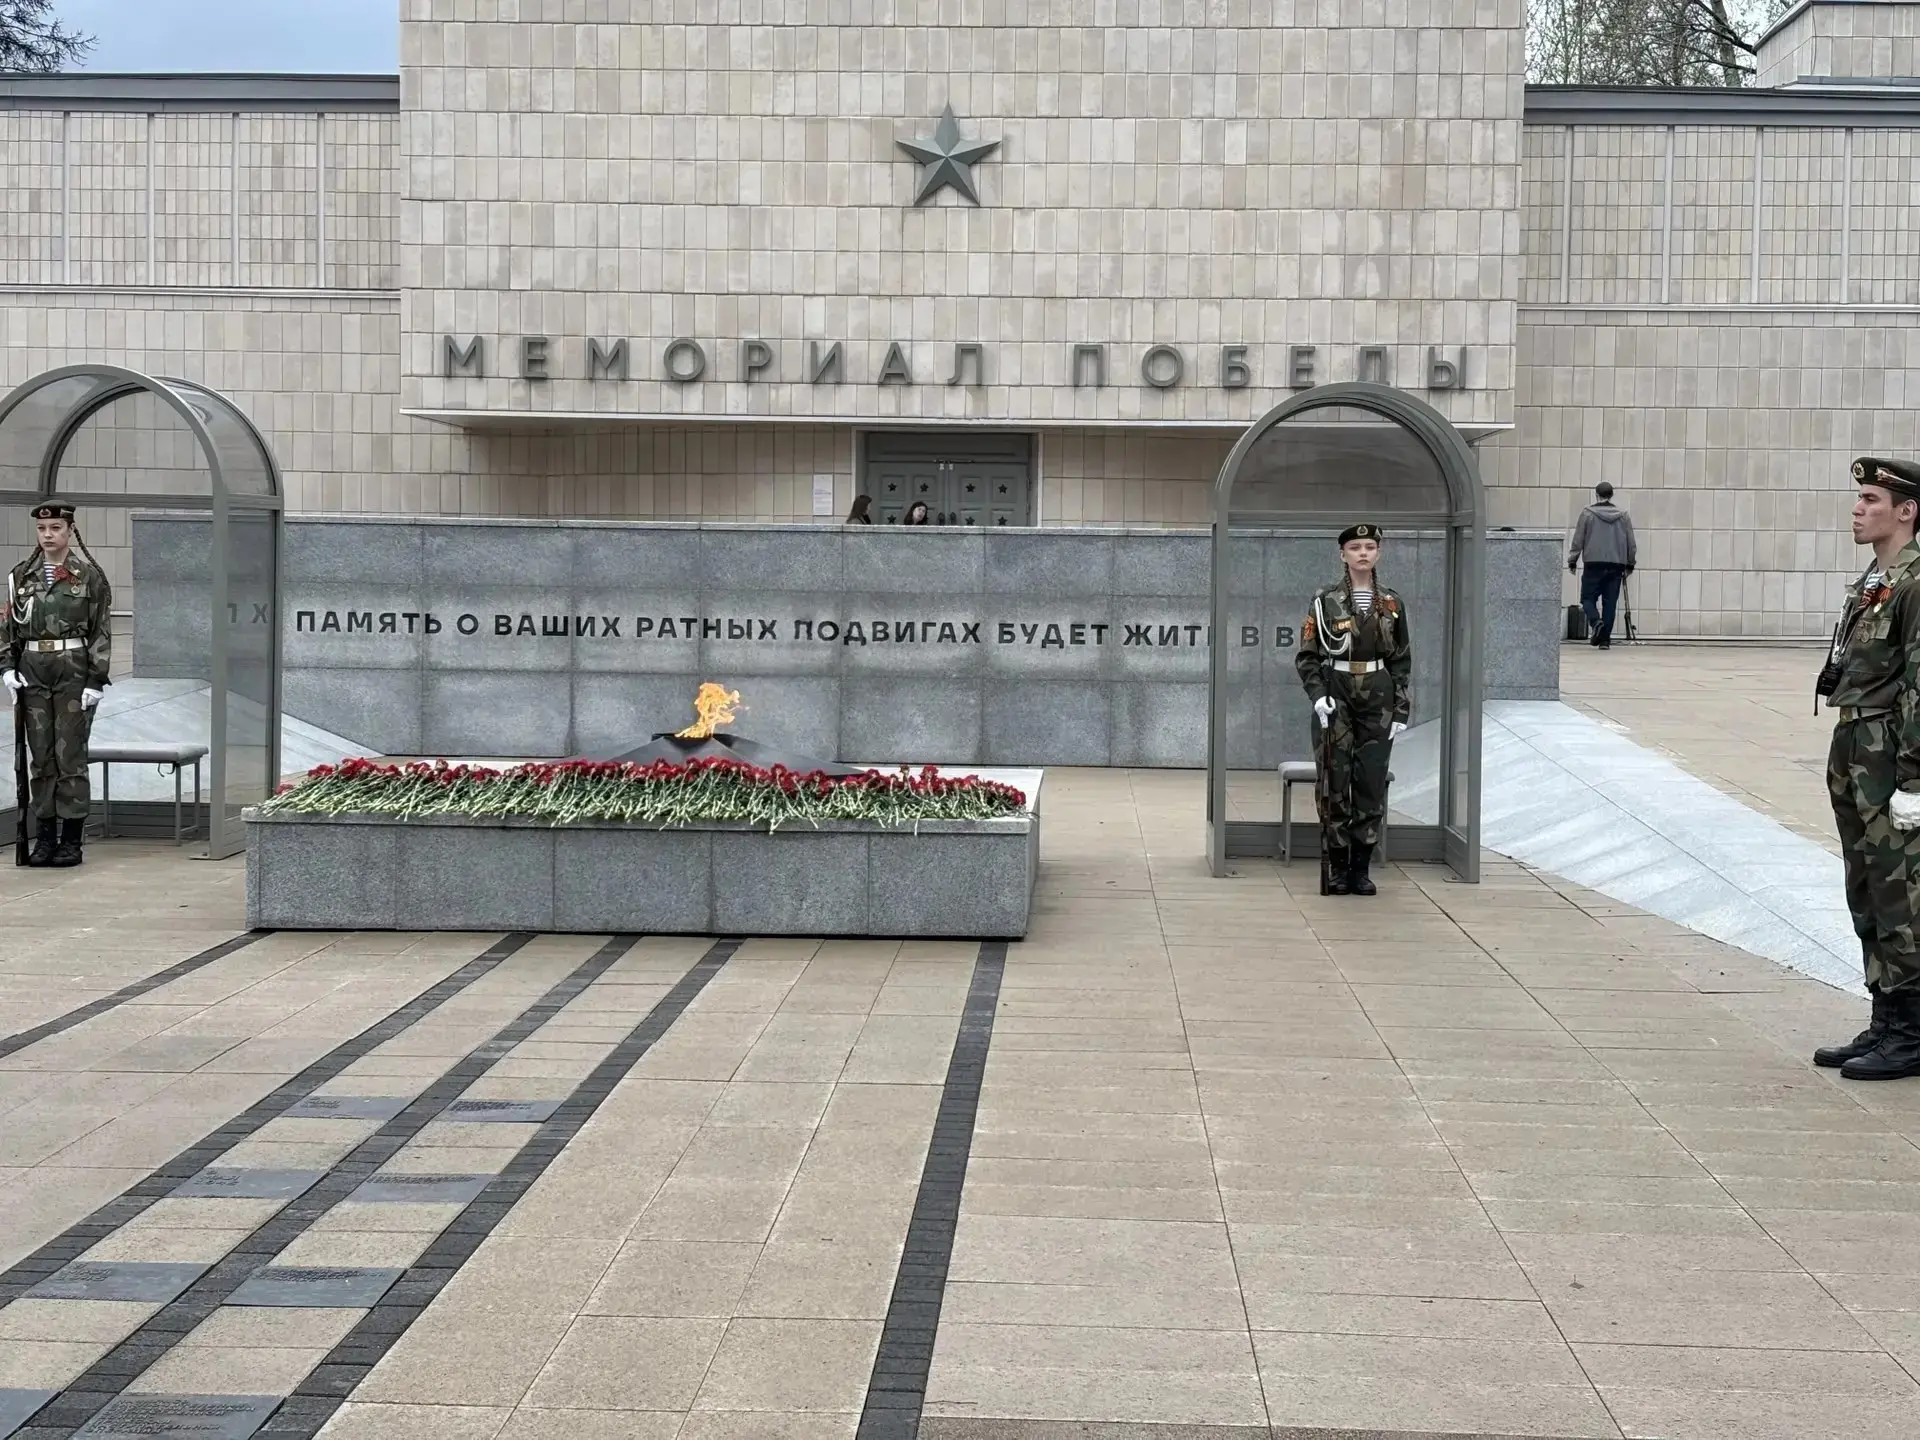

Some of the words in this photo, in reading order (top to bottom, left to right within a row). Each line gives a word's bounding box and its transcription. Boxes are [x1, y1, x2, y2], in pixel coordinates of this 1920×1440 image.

[443, 335, 983, 386] МЕМОРИАЛ
[1073, 343, 1467, 389] ПОБЕДЫ
[296, 610, 442, 635] ПАМЯТЬ
[456, 613, 479, 636] О
[494, 614, 622, 638] ВАШИХ
[636, 616, 777, 641] РАТНЫХ
[794, 619, 981, 647] ПОДВИГАХ
[998, 623, 1108, 649] БУДЕТ
[1123, 625, 1211, 647] ЖИТ
[1241, 626, 1260, 648] В
